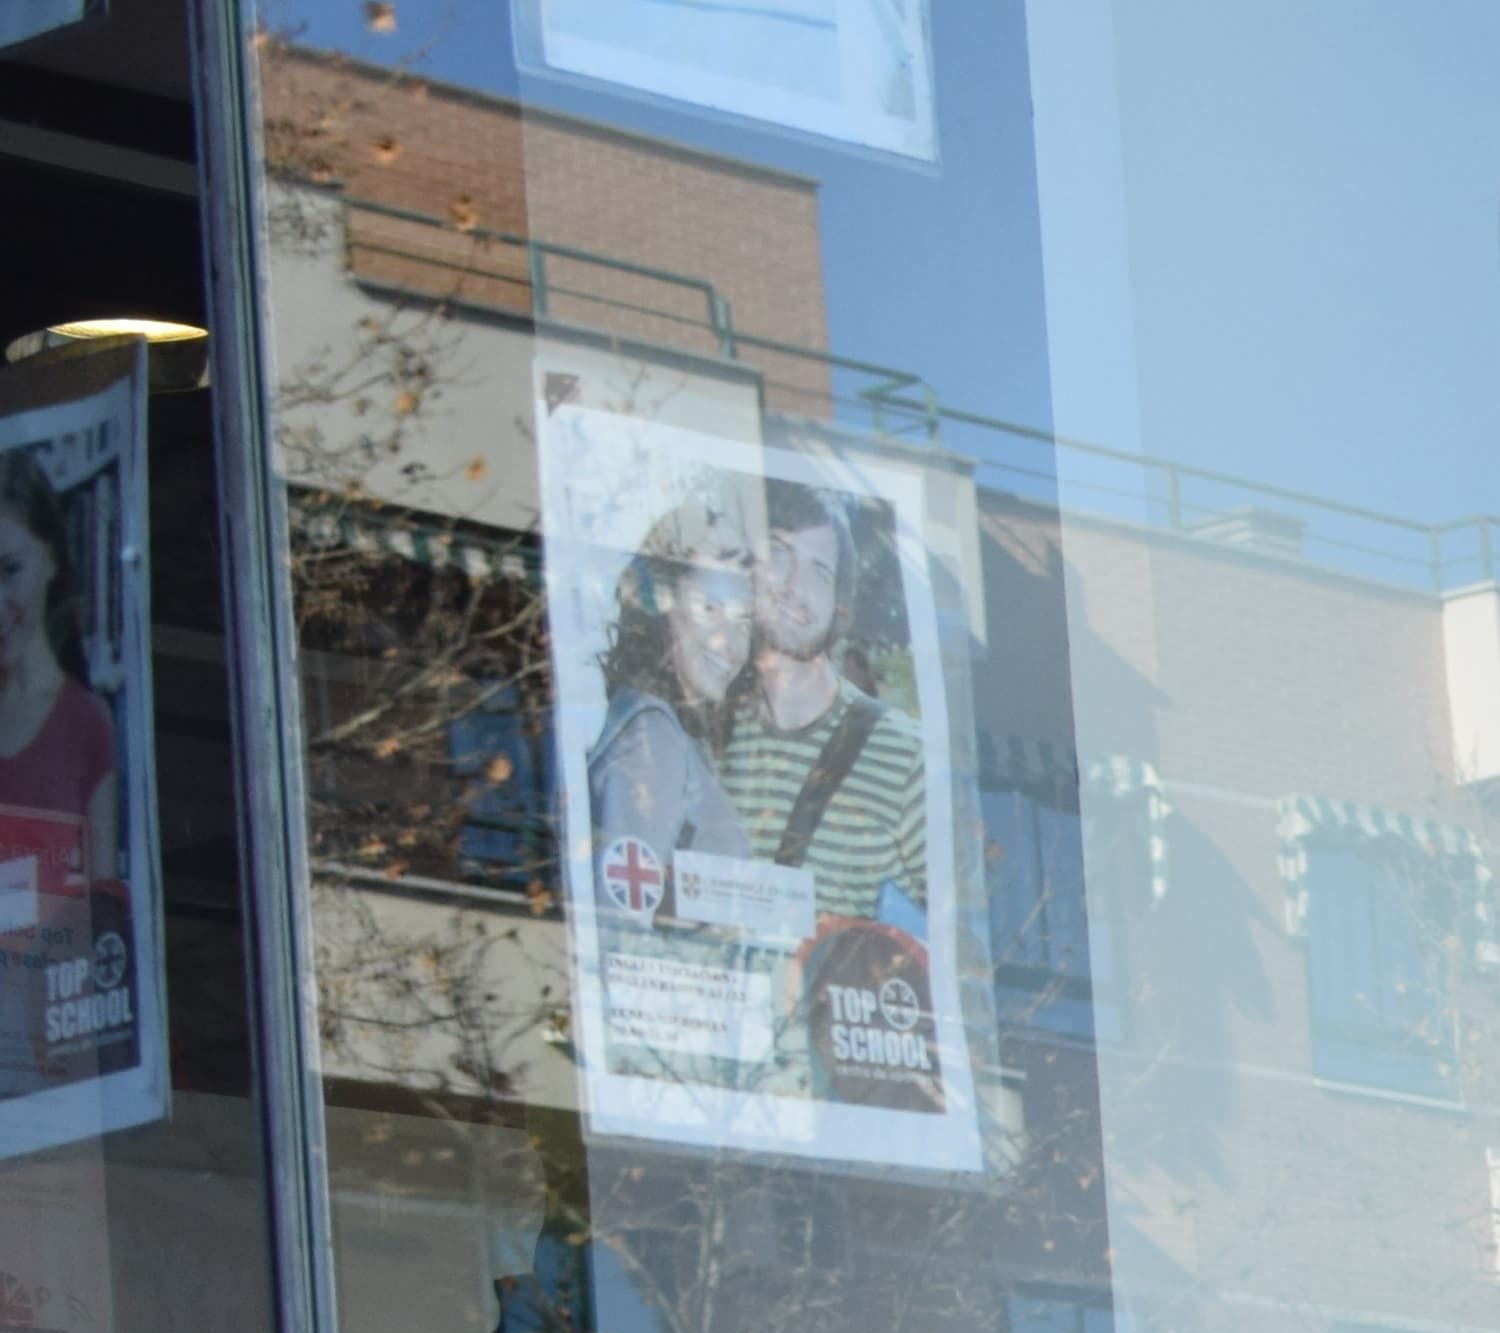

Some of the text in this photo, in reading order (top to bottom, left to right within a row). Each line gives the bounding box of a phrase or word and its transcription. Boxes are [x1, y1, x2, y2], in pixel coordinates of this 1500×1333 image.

[45, 958, 89, 1002] TOP
[45, 986, 134, 1042] SCHOOL
[827, 983, 878, 1024] TOP
[832, 1024, 934, 1071] SCHOOL
